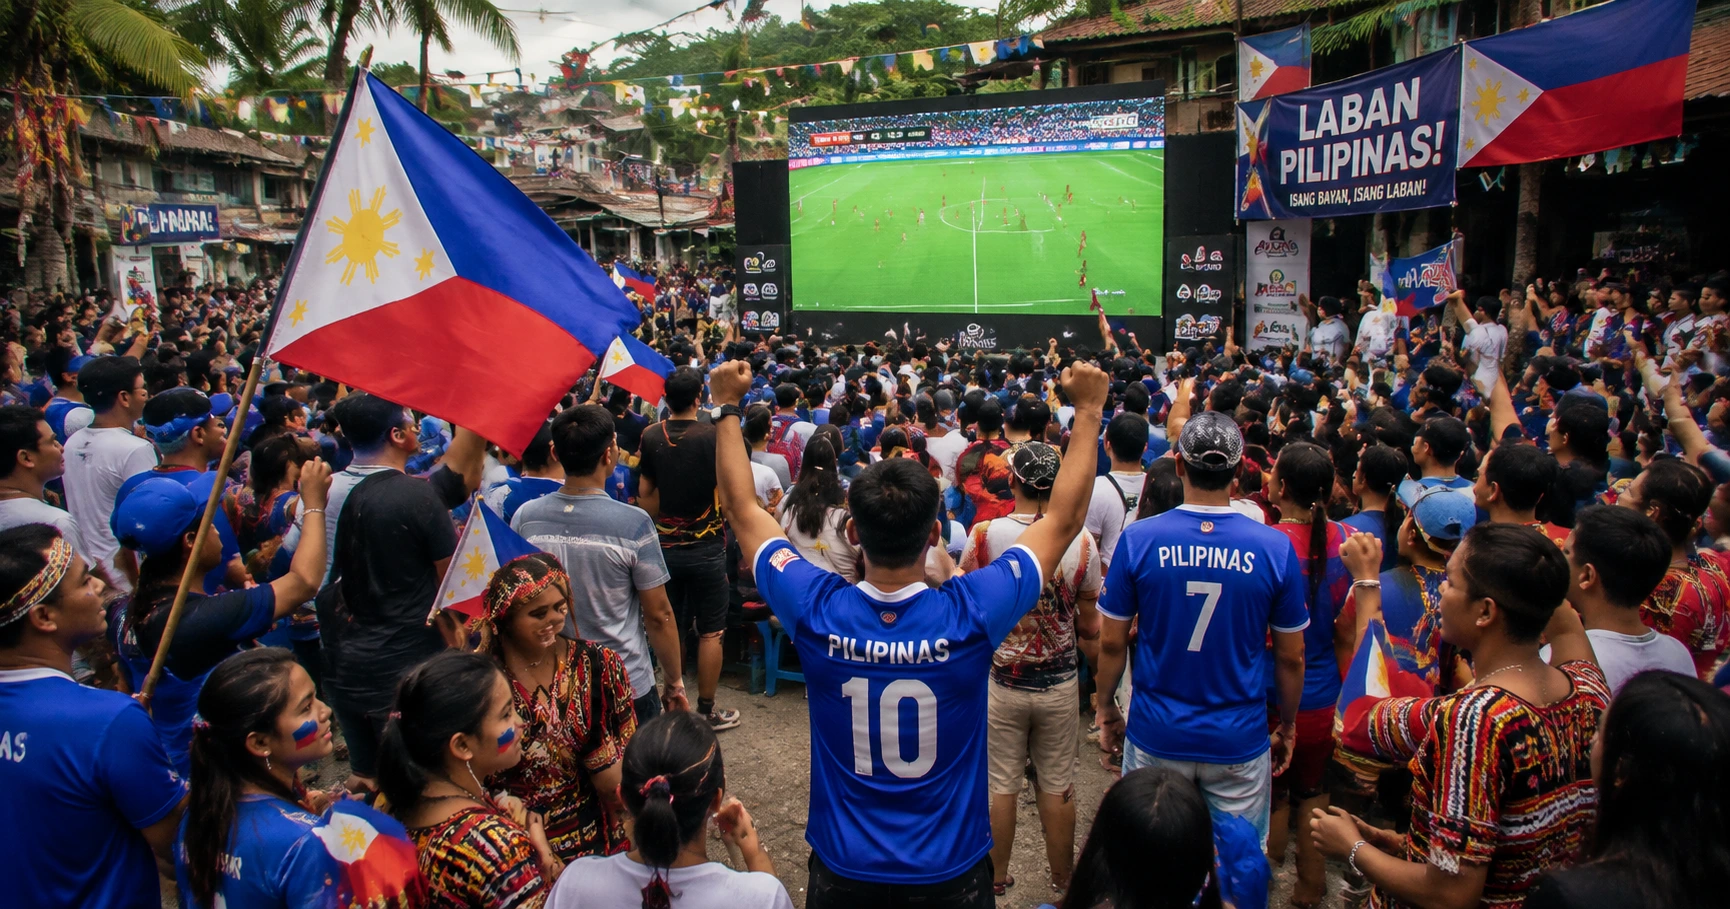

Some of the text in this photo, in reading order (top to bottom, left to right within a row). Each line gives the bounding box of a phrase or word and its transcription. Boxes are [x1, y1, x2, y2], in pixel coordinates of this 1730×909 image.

[1299, 76, 1421, 142] LABAN
[1280, 120, 1446, 185] PILIPINAS!
[1289, 179, 1427, 207] ISANG BAYAN, ISANG LABAN!
[1158, 545, 1255, 574] PILIPINAS
[1186, 580, 1223, 652] 7
[827, 634, 951, 664] PILIPINAS
[841, 676, 938, 779] 10
